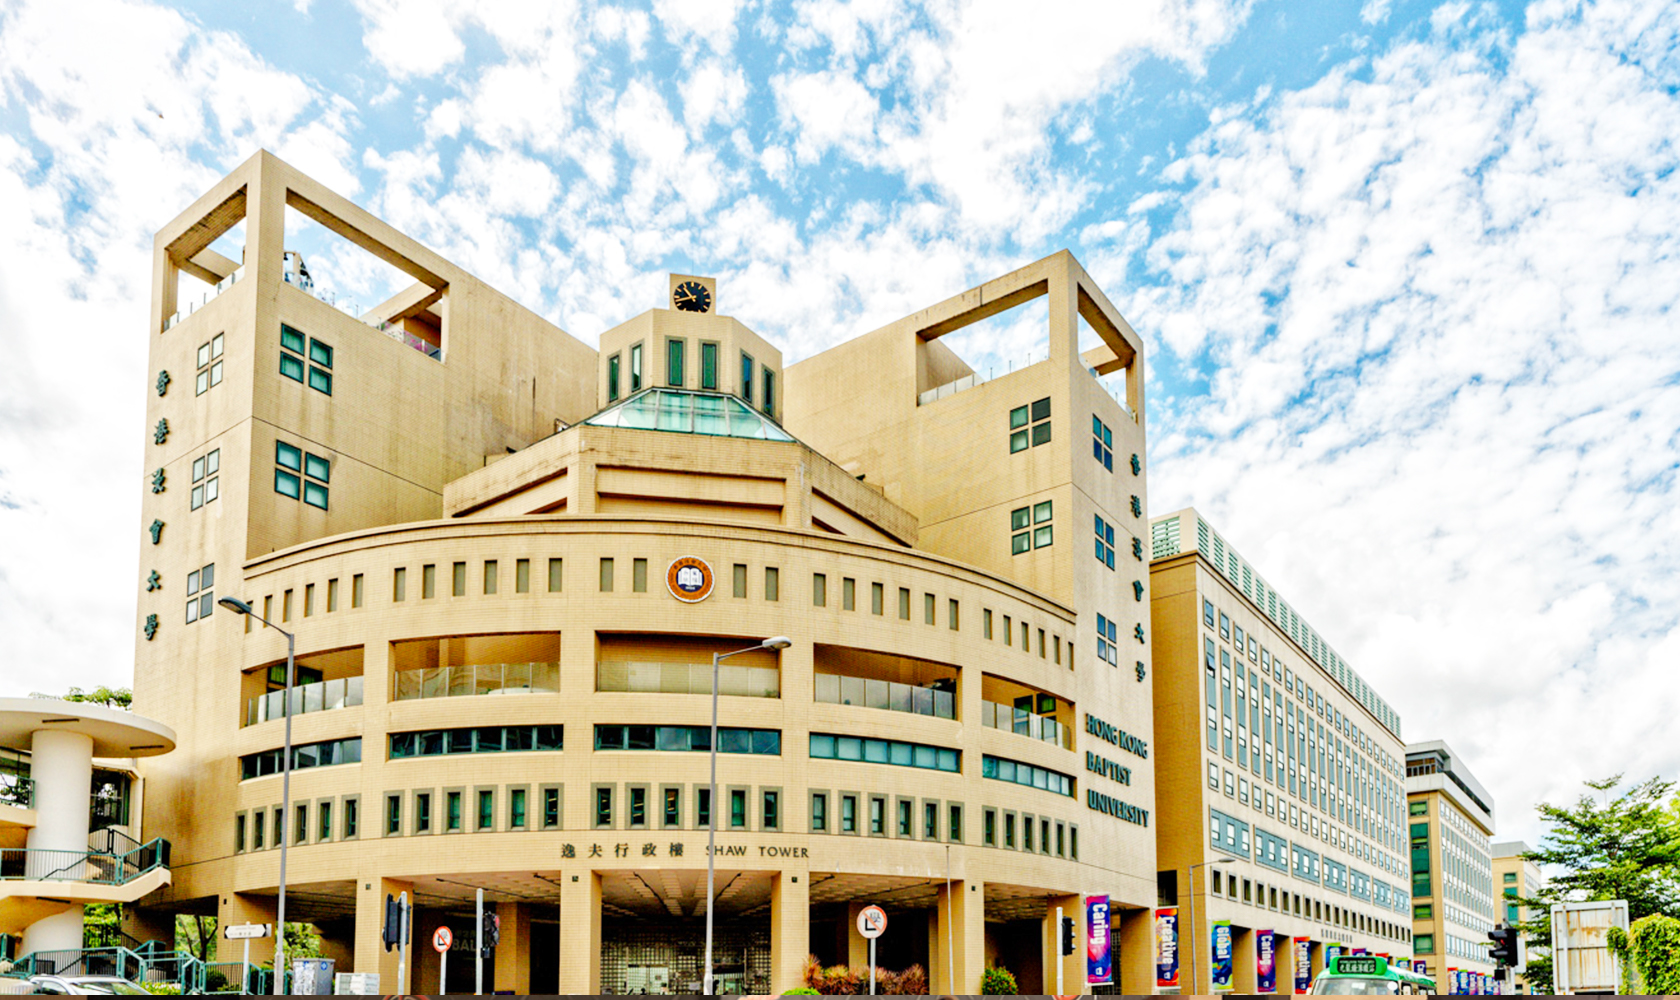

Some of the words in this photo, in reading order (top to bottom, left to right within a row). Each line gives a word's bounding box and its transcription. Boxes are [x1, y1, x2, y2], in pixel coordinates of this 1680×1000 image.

[1085, 712, 1118, 746] HONG
[1119, 729, 1149, 760] KONG
[1085, 750, 1132, 787] BAPTIST
[1086, 788, 1150, 828] UNIVERSITY
[758, 846, 809, 859] TOWER
[1089, 903, 1108, 945] Caring
[1161, 916, 1177, 965] Creative
[1216, 926, 1231, 959] Global
[1259, 935, 1274, 966] Caring
[1298, 941, 1311, 979] Creative
